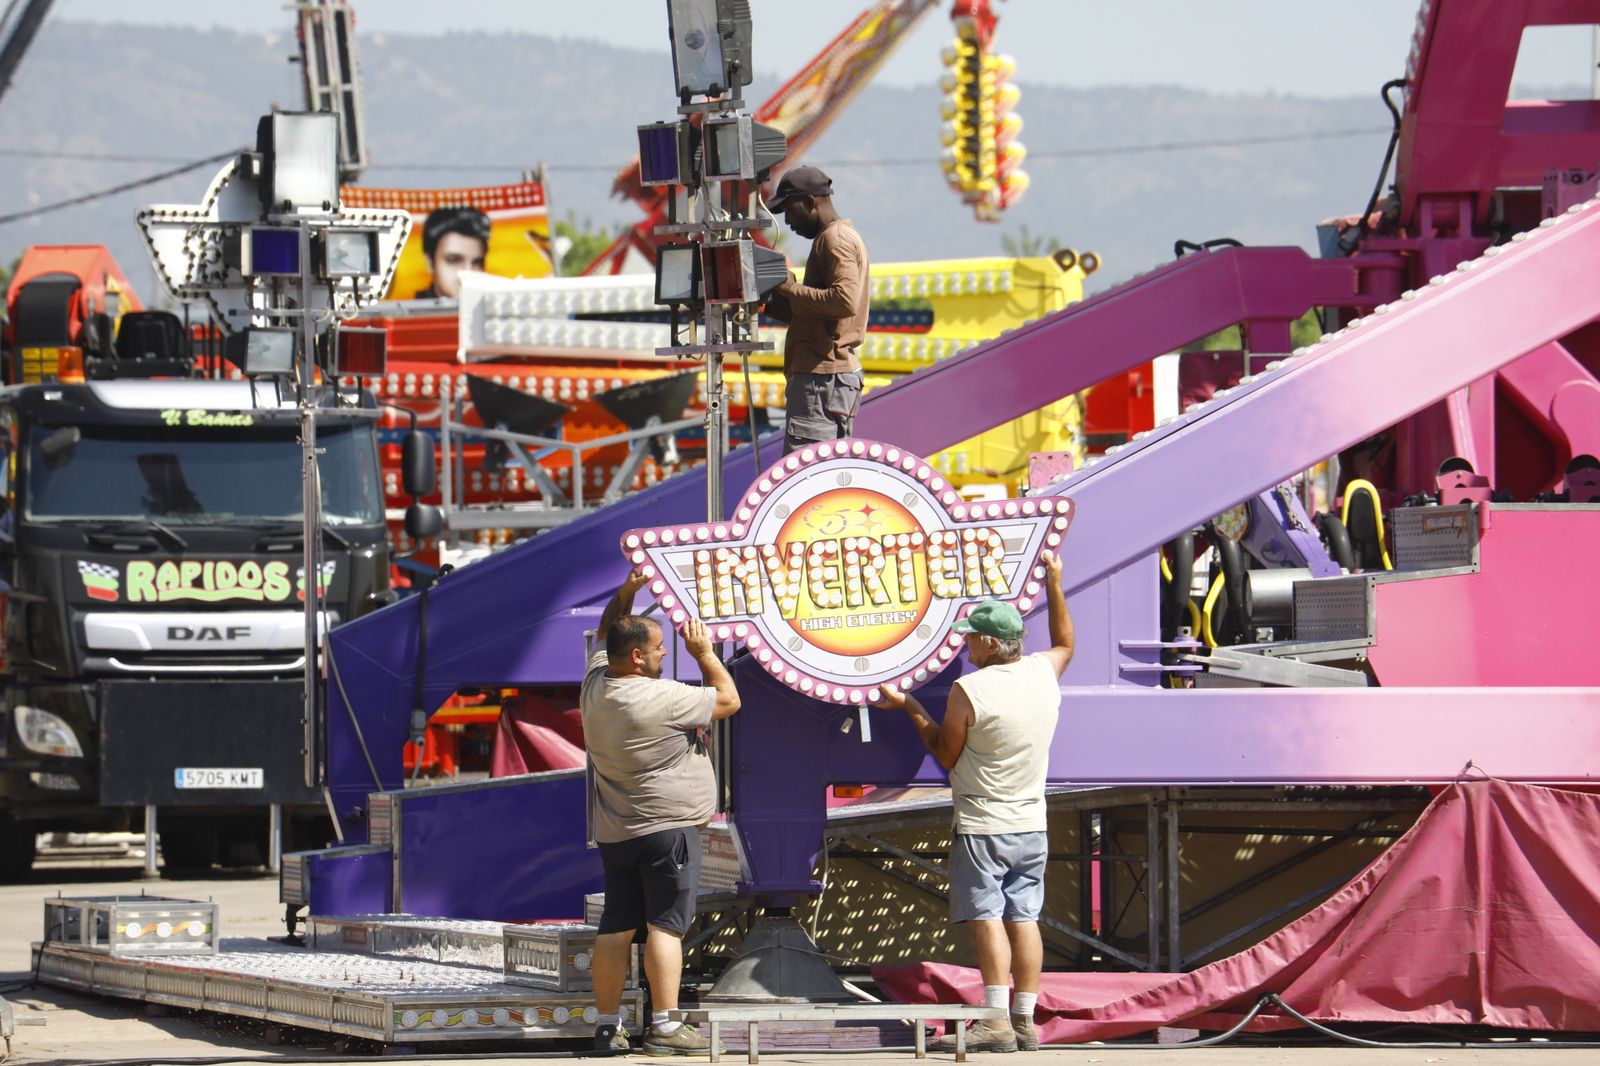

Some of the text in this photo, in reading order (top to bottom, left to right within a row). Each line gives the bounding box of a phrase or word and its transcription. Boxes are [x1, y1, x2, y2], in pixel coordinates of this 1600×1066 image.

[126, 560, 291, 602] RAPIDOS
[694, 527, 1011, 620] INVERTER
[800, 610, 918, 631] HIGH ENERGY
[166, 626, 251, 641] DAF
[185, 770, 225, 786] 5705
